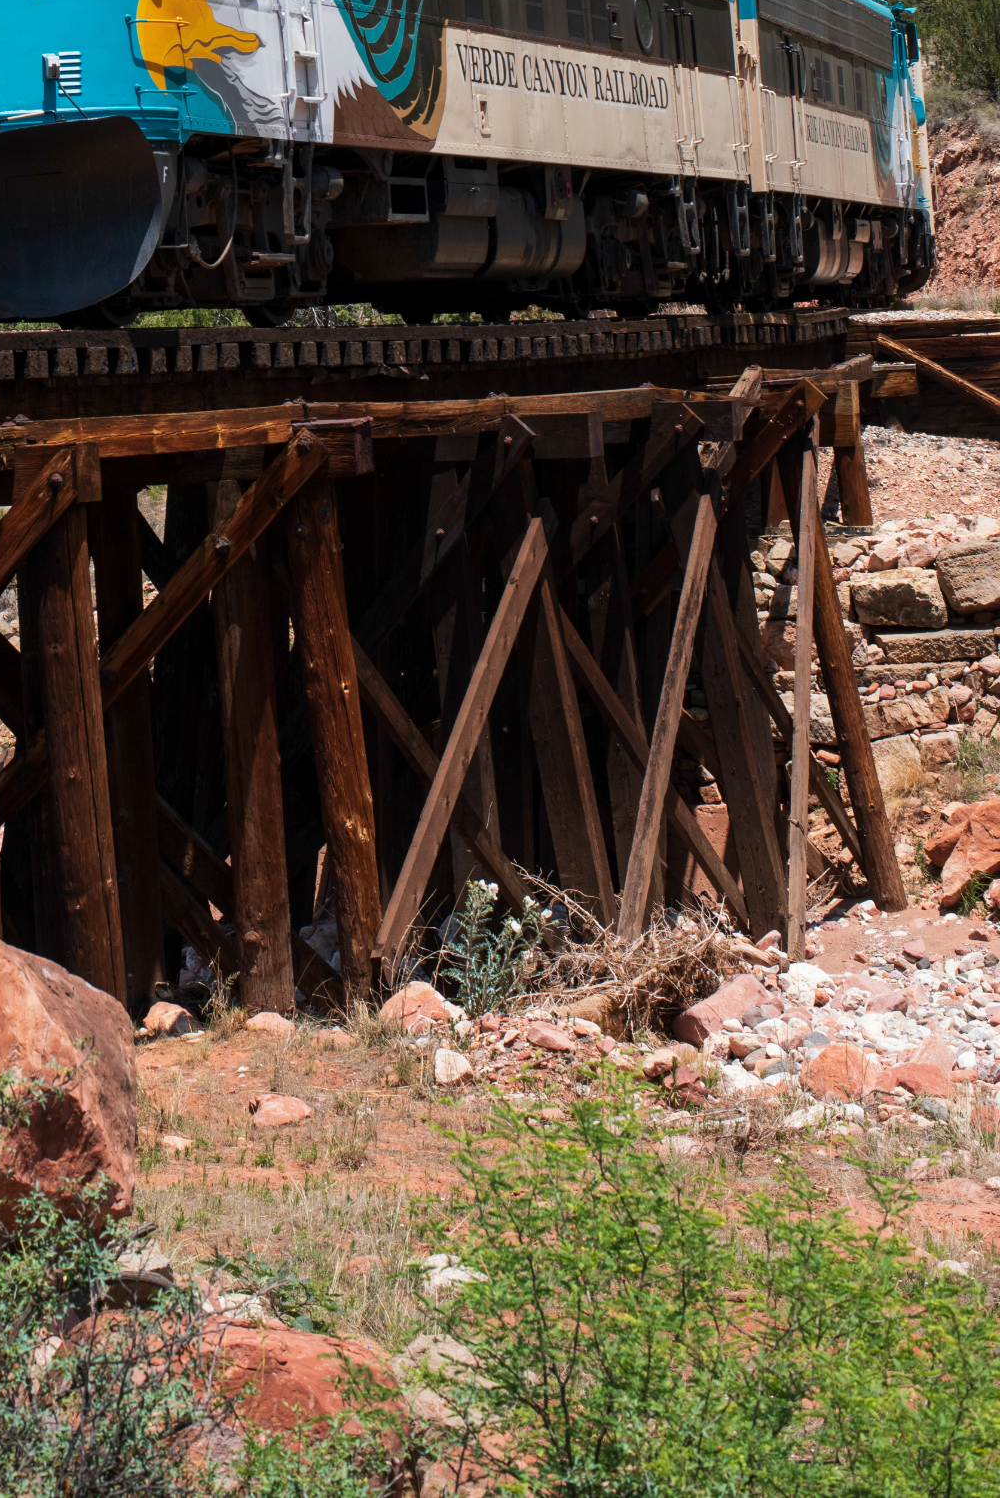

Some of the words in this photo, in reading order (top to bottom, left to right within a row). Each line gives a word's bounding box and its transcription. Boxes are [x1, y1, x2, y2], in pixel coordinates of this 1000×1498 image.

[455, 43, 519, 89] VERDE
[522, 54, 589, 99] CANYON
[592, 66, 669, 110] RAILROAD
[162, 165, 169, 183] F
